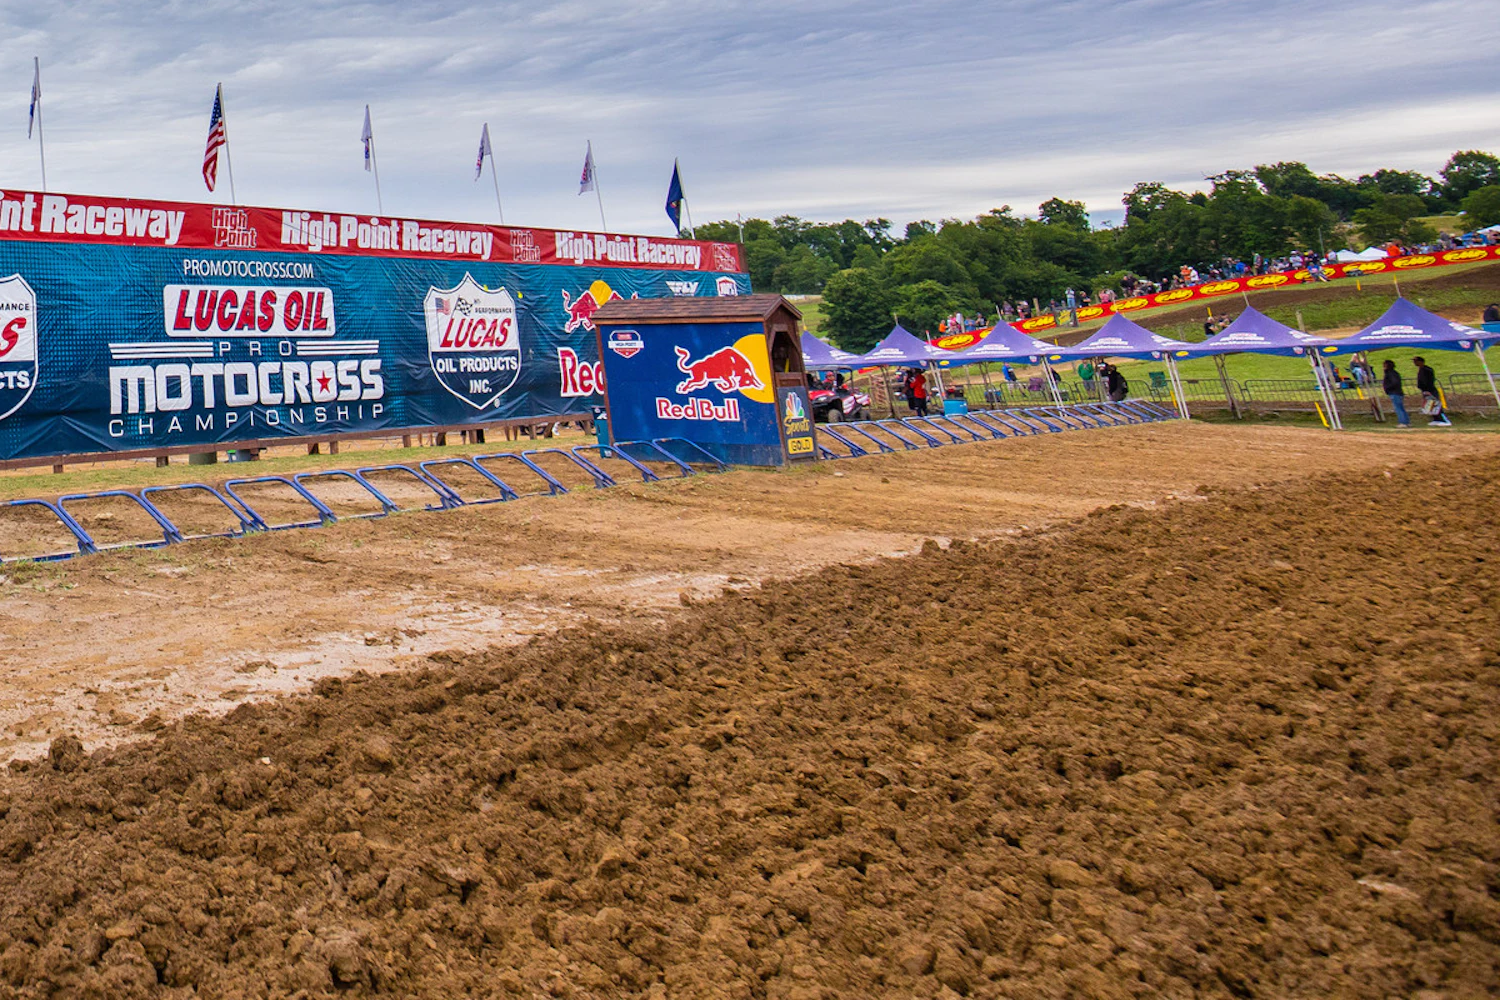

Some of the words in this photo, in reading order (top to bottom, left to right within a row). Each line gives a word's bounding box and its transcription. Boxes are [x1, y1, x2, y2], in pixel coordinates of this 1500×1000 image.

[40, 195, 185, 245] Raceway
[212, 208, 248, 230] High
[214, 228, 257, 248] Point
[281, 211, 337, 252] High
[340, 216, 399, 250] Point
[402, 220, 494, 260] Raceway
[510, 229, 534, 248] High
[513, 245, 541, 262] Point
[555, 231, 593, 264] High
[594, 234, 636, 262] Point
[637, 237, 701, 269] Raceway
[184, 259, 314, 279] PROMOTOCROSS.COM
[174, 289, 276, 332] LUCAS
[283, 291, 328, 332] OIL
[440, 318, 512, 348] LUCAS
[219, 340, 293, 357] PRO
[436, 358, 457, 373] OIL
[460, 356, 518, 372] PRODUCTS
[109, 359, 384, 414] MOTOCROSS
[469, 380, 492, 394] INC.
[108, 403, 384, 438] CHAMPIONSHIP
[656, 397, 699, 420] Red
[699, 397, 740, 422] Bull
